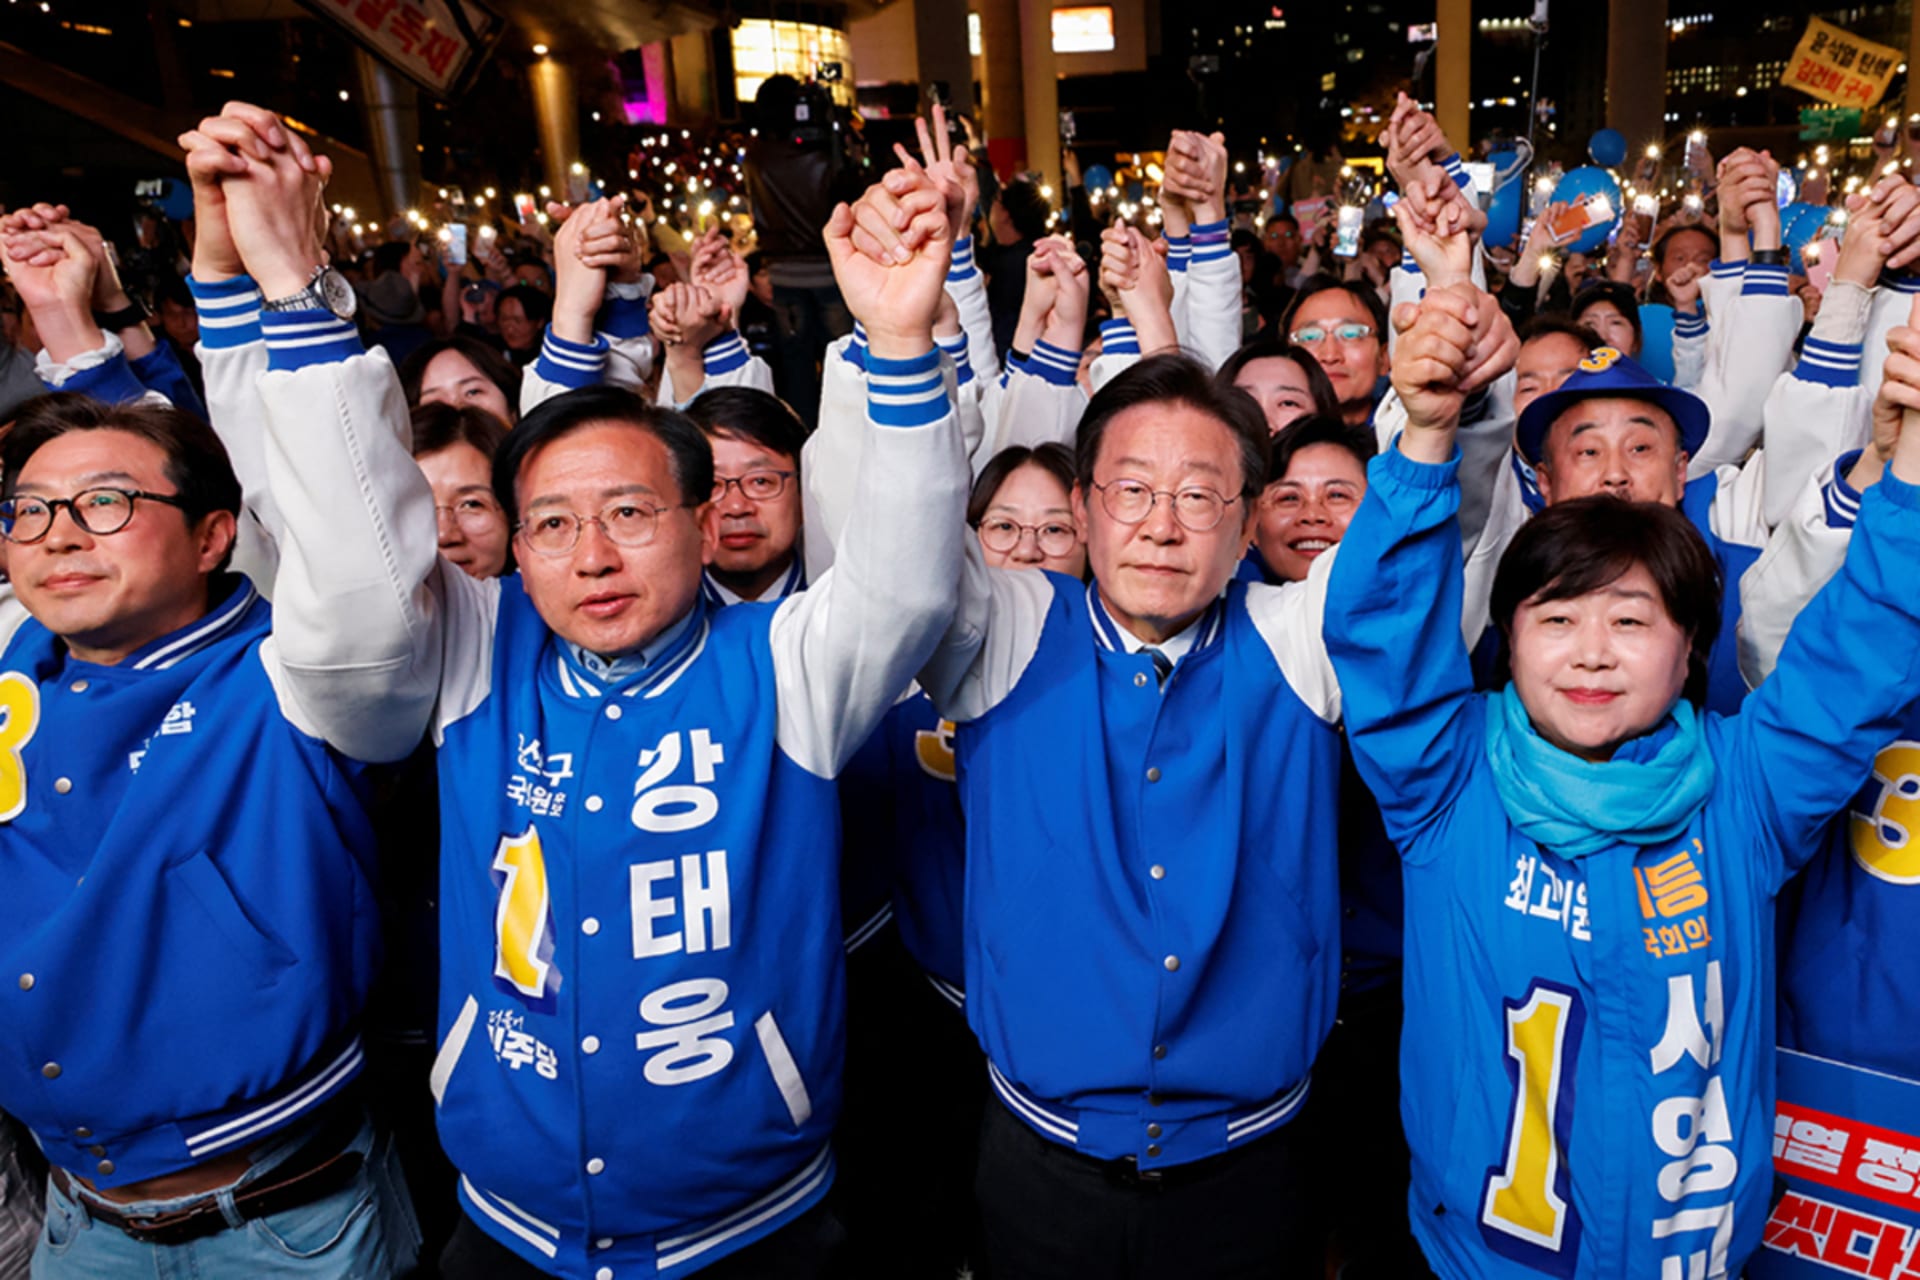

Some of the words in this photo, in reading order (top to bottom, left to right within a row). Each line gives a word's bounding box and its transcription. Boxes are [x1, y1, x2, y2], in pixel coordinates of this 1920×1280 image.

[1795, 57, 1846, 94] 김건희
[1810, 31, 1858, 69] 윤석열
[1857, 51, 1893, 80] 탄핵
[1578, 346, 1622, 373] 3
[517, 732, 575, 787] 산구
[492, 823, 549, 999] 1
[630, 728, 735, 1086] 강태웅
[1642, 915, 1712, 959] 국회의
[1482, 986, 1572, 1252] 1
[1856, 1138, 1920, 1200] 정
